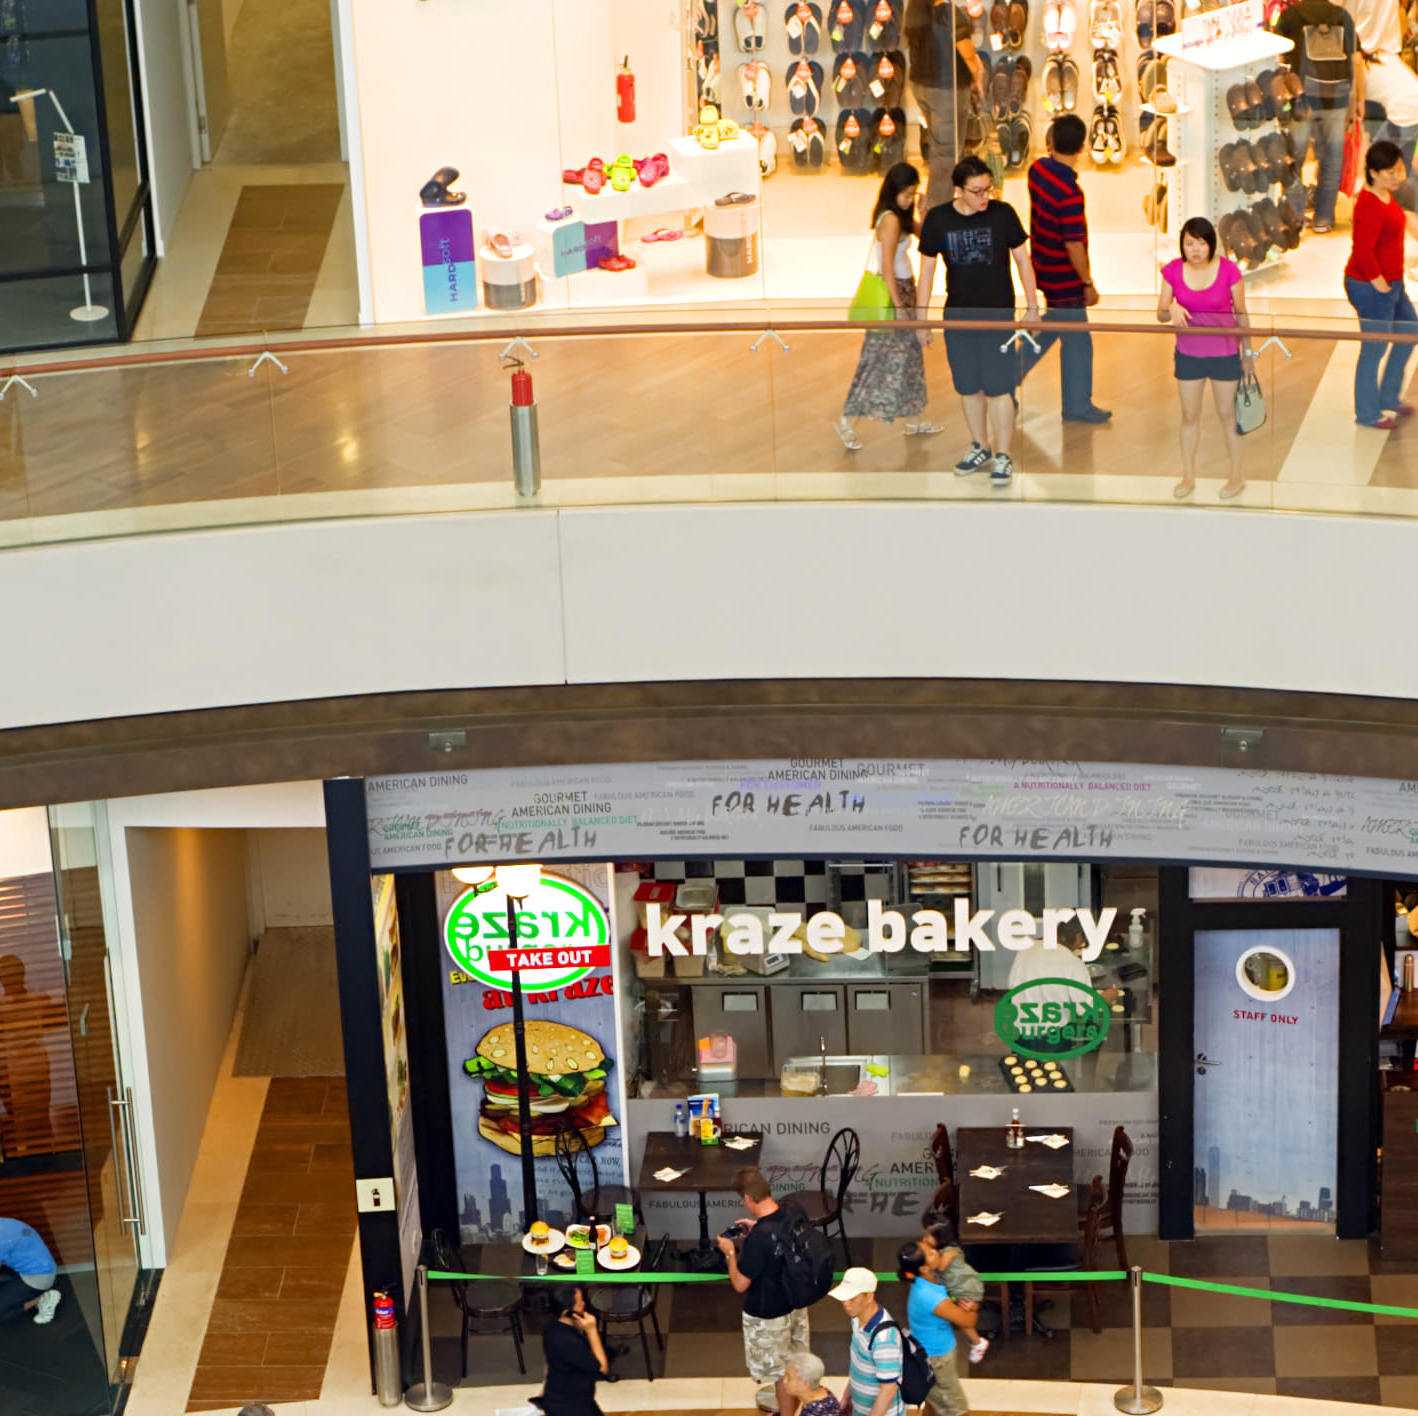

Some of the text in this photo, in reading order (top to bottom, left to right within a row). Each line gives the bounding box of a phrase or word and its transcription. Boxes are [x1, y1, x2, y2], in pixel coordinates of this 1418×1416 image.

[768, 770, 826, 780] AMERICAN
[368, 774, 468, 793] AMERICAN DINING
[1021, 782, 1084, 790] NUTRITIONALLY
[1088, 783, 1131, 791] BALANCED
[1133, 784, 1151, 792] DIET
[533, 791, 588, 804] GOURMET
[711, 790, 865, 816] FOR HEALTH
[511, 802, 612, 817] AMERICAN DINING
[809, 824, 903, 832] FABULOUS AMERICAN FOOD
[445, 825, 596, 858] FOR HEALTH
[960, 825, 1114, 850] FOR HEALTH
[383, 844, 421, 853] AMERICAN
[1366, 847, 1406, 858] FABULOUS
[646, 898, 1117, 962] kraze bakery
[507, 950, 592, 967] TAKE OUT
[1233, 1009, 1298, 1025] STAFF ONLY
[777, 1122, 830, 1135] DINING
